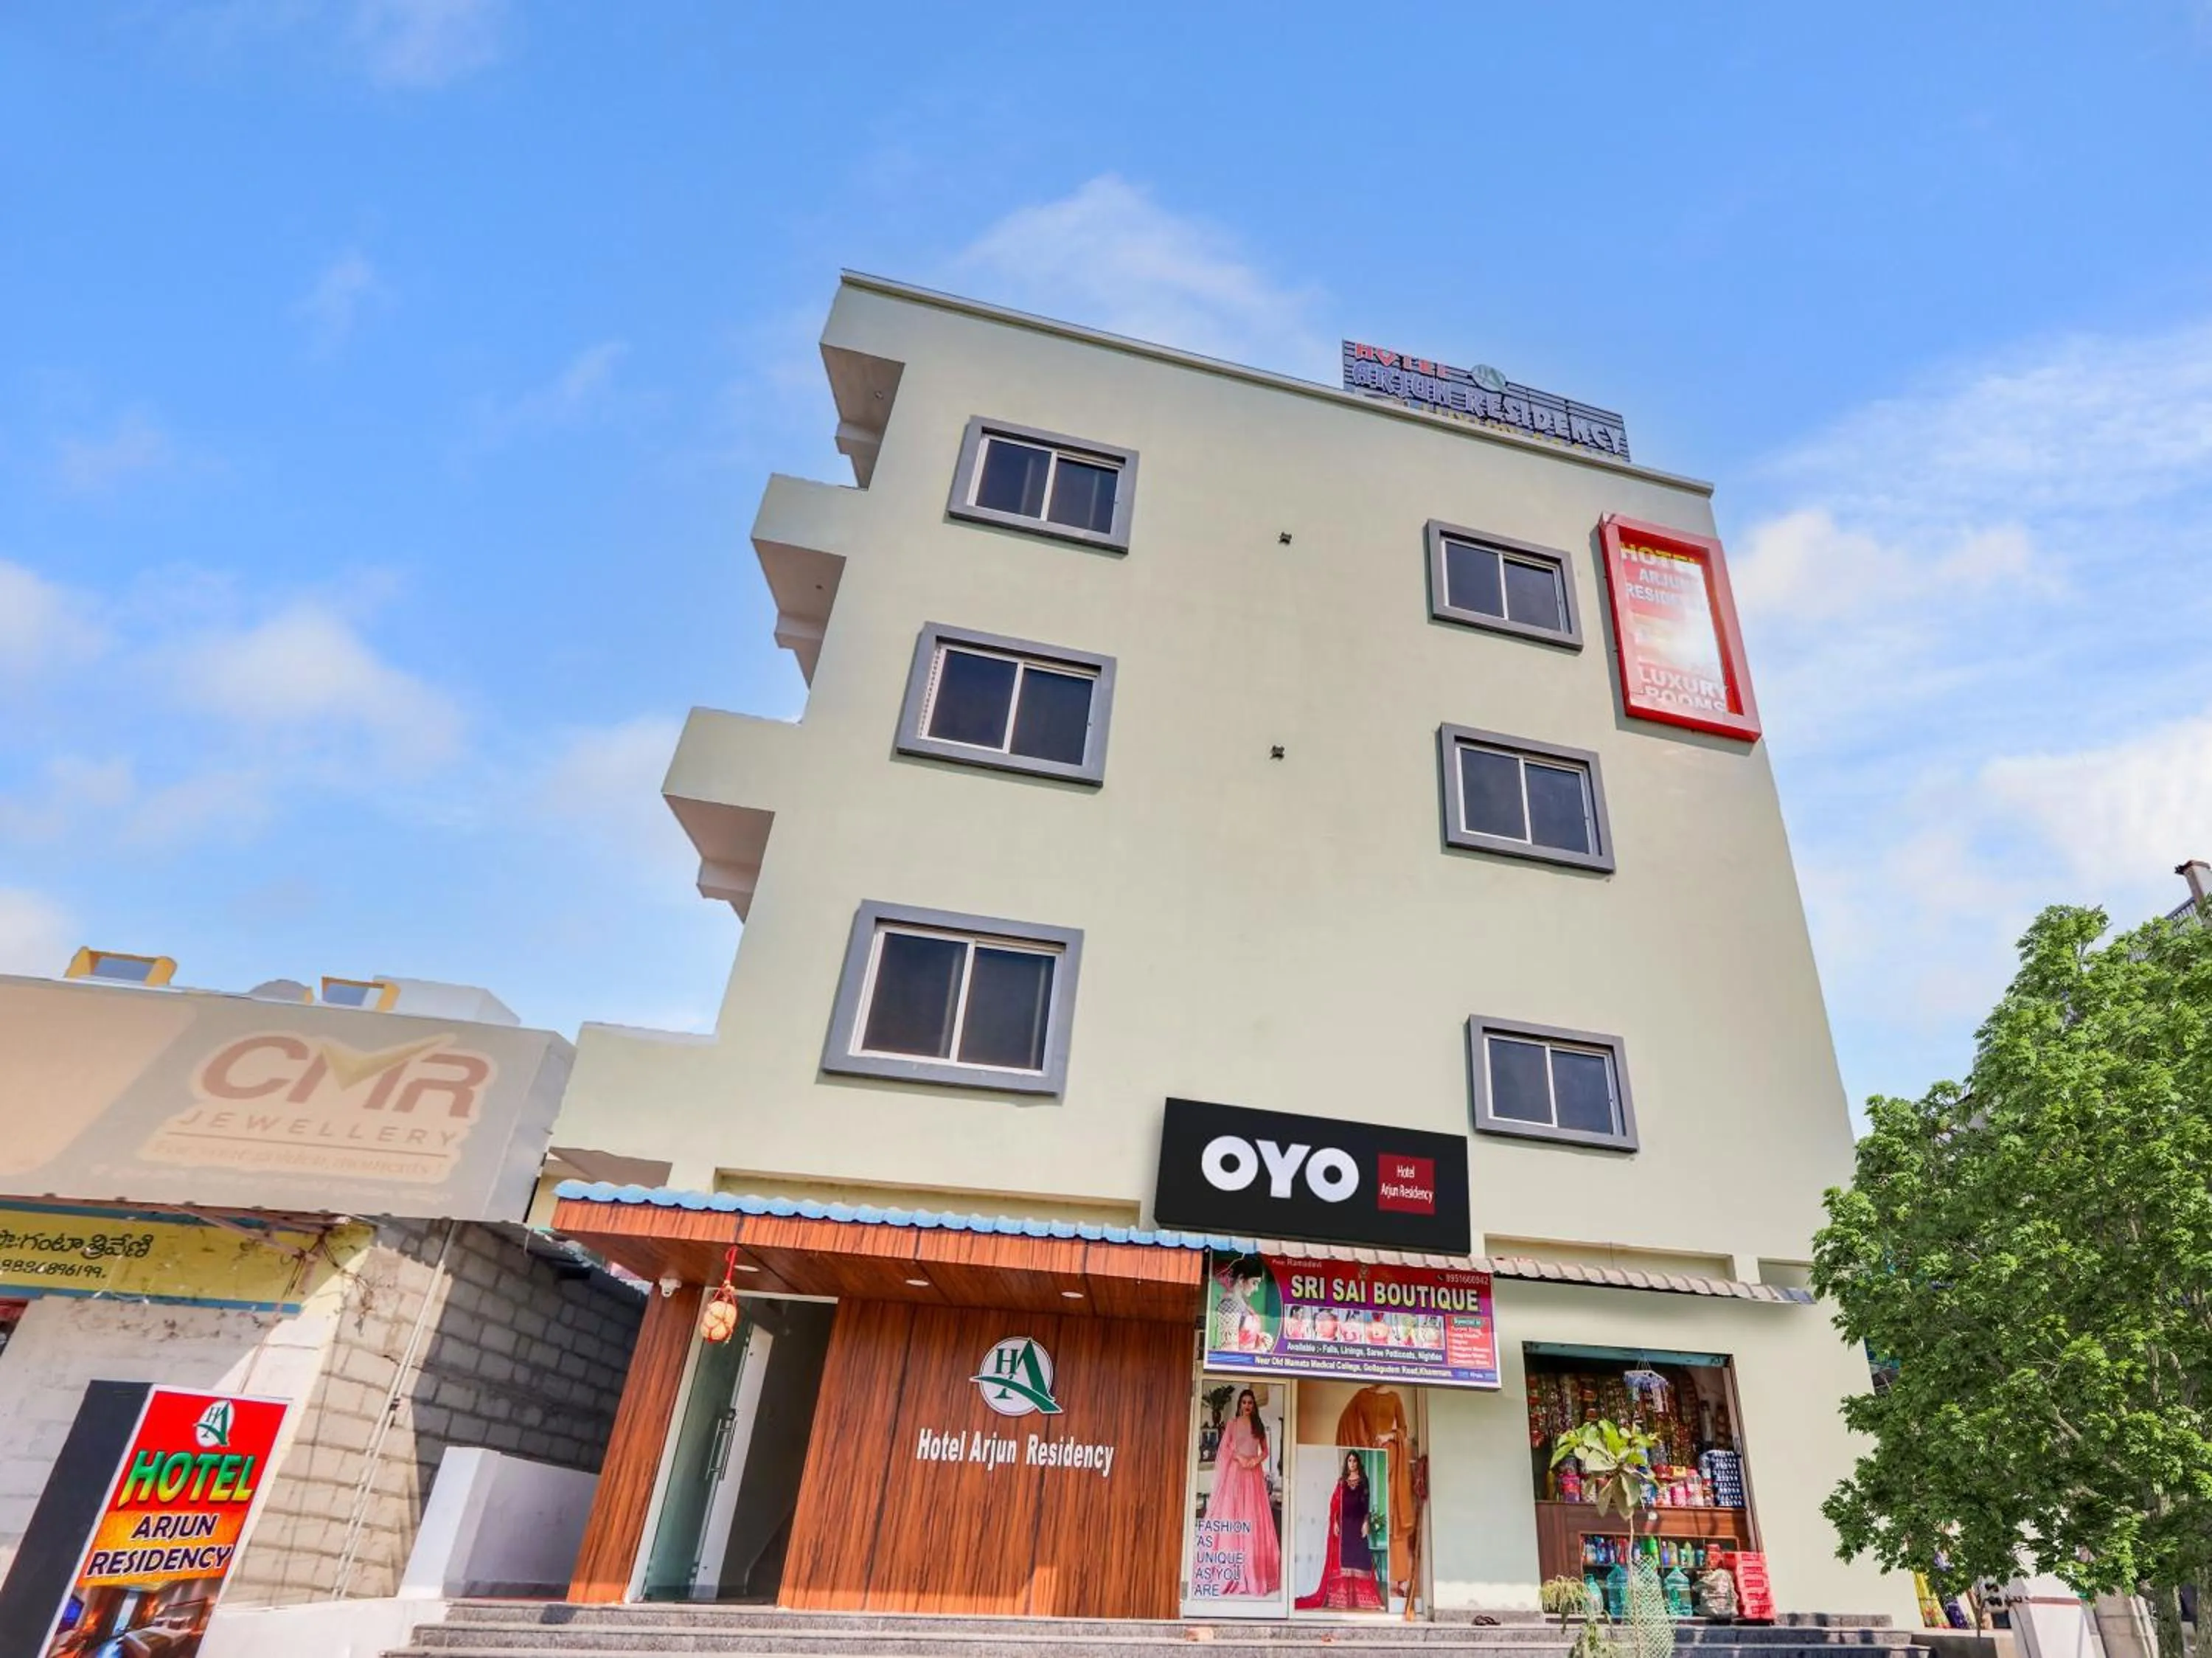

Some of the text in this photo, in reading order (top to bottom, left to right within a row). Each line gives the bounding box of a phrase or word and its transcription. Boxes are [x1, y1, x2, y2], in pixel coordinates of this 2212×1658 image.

[1352, 361, 1452, 406] ARJUN
[1465, 388, 1624, 454] RESIDENCY
[201, 1034, 490, 1119] CMR
[178, 1110, 462, 1148] JEWELLERY
[1201, 1135, 1360, 1203] OYO
[1397, 1165, 1415, 1179] Hotel
[1380, 1182, 1433, 1204] Arjun Residency
[1291, 1274, 1479, 1311] SRI SAI BOUTIQUE
[917, 1427, 1115, 1477] Hotel Arjun Residency
[118, 1450, 256, 1508] HOTEL
[131, 1513, 220, 1540] ARJUN
[1197, 1519, 1251, 1533] FASHION
[1197, 1535, 1214, 1548] AS
[86, 1544, 234, 1577] RESIDENCY
[1197, 1551, 1244, 1564] UNIQUE
[1195, 1567, 1241, 1581] AS YOU
[1194, 1584, 1220, 1597] ARE
